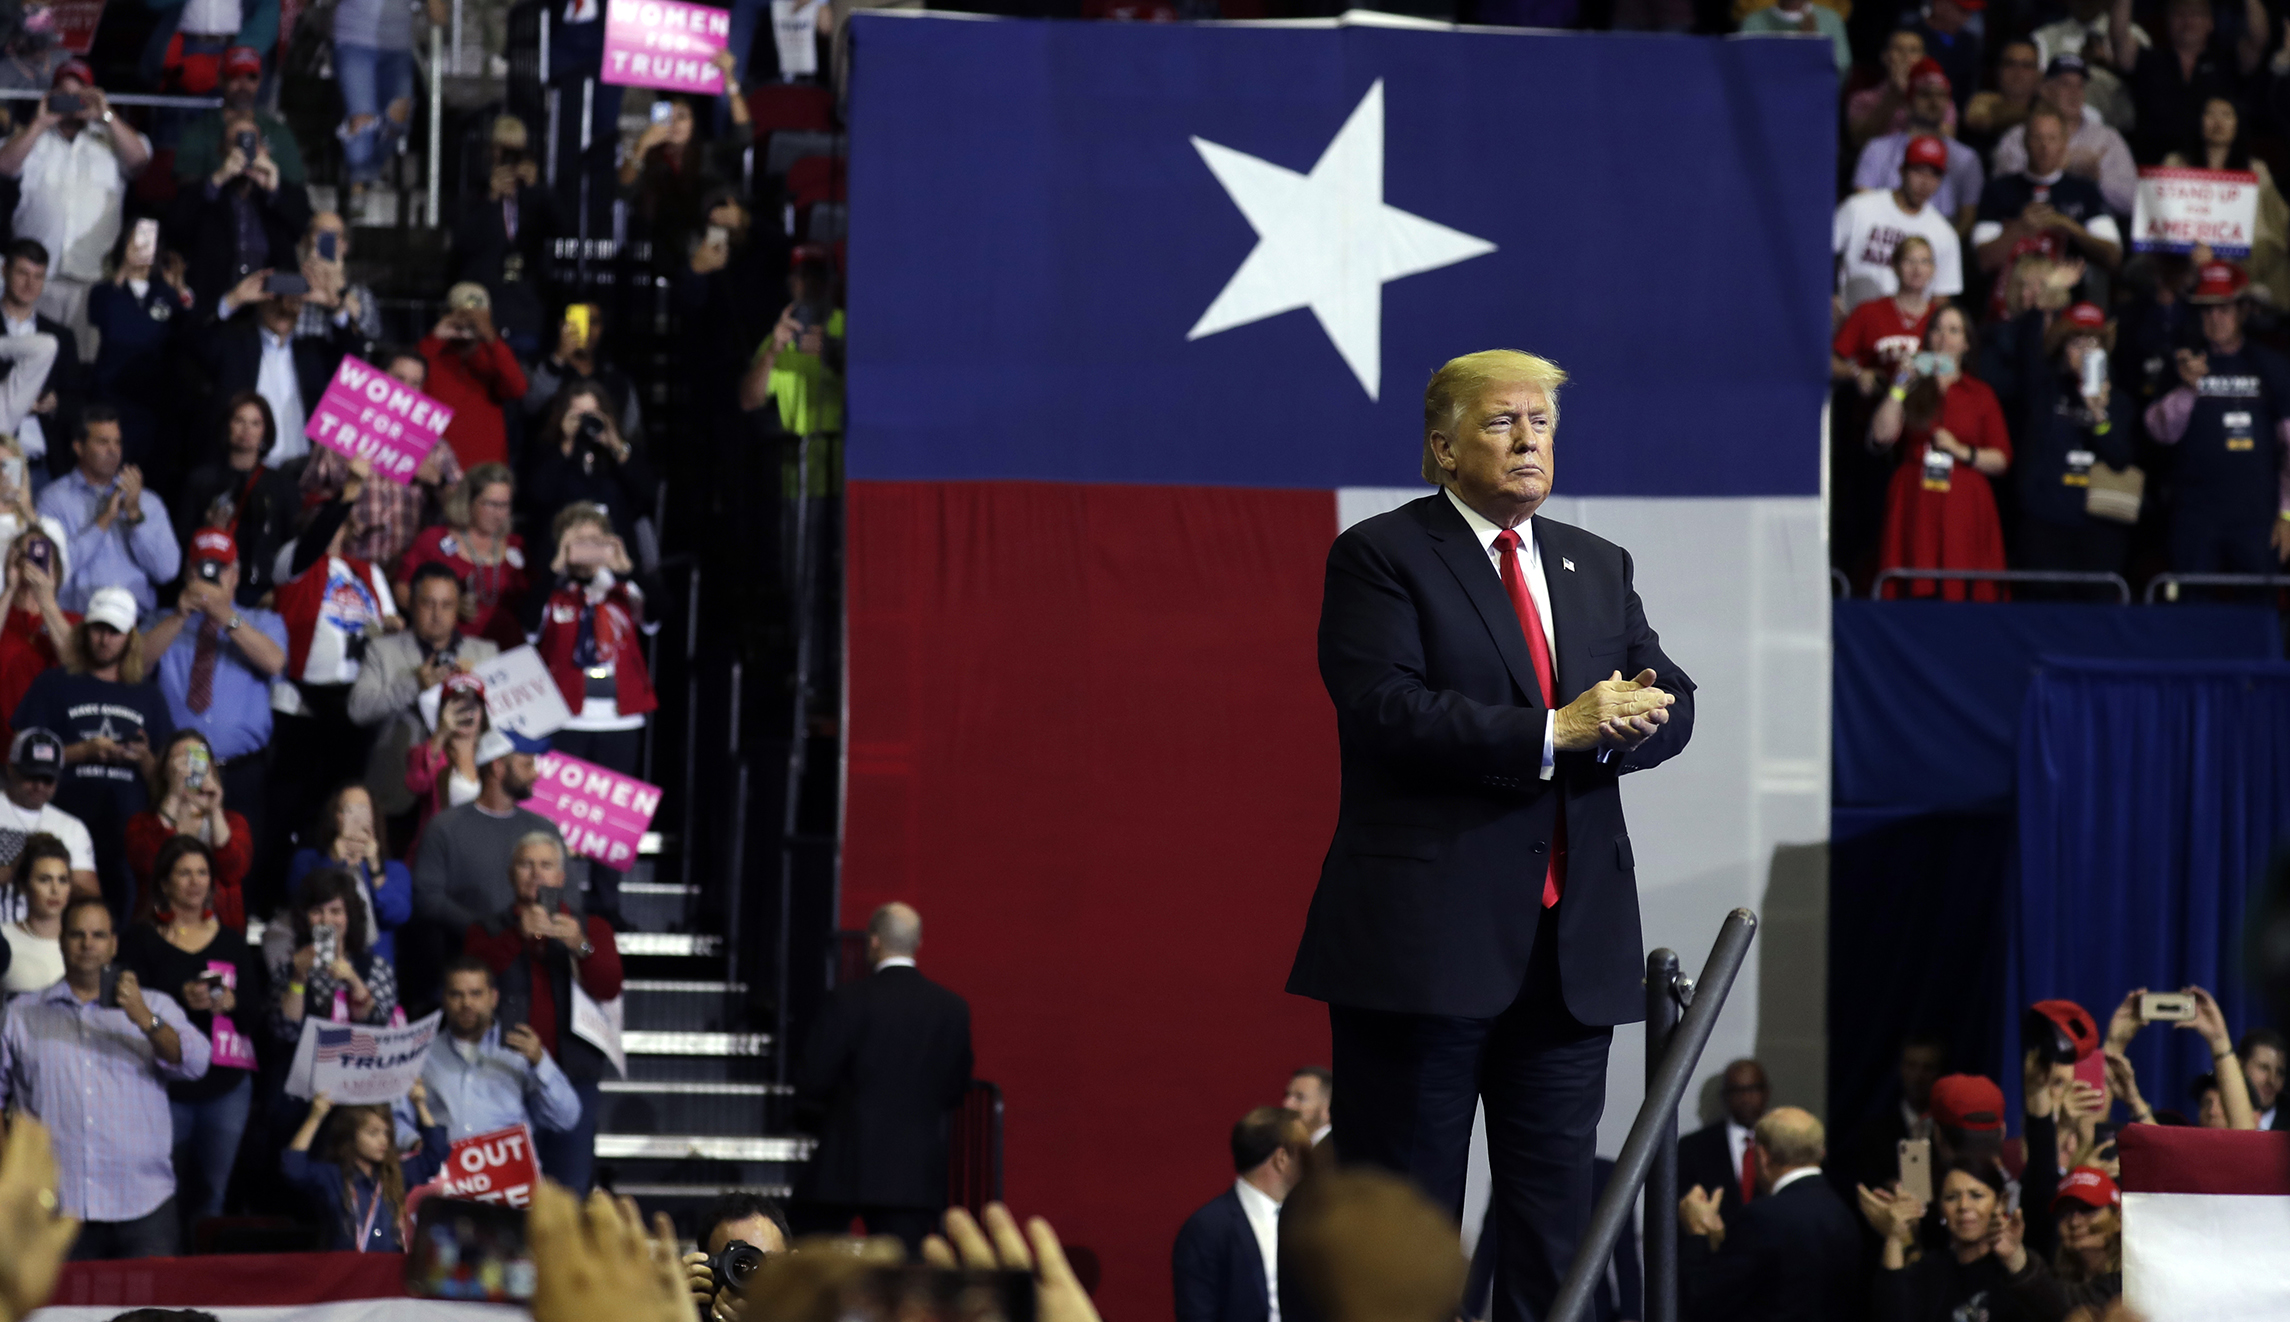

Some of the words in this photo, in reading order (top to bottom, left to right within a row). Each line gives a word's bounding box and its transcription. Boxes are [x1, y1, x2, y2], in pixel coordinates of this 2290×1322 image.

[611, 1, 729, 37] WOMEN
[645, 31, 691, 50] FOR
[611, 50, 721, 83] TRUMP
[2147, 218, 2244, 241] AMERICA
[339, 360, 451, 436] WOMEN
[359, 406, 418, 440] FOR
[318, 411, 416, 475] TRUMP
[534, 754, 660, 818] WOMEN
[556, 794, 605, 825] FOR
[559, 821, 631, 864] UMP
[460, 1134, 523, 1173] OUT
[442, 1172, 492, 1197] AND
